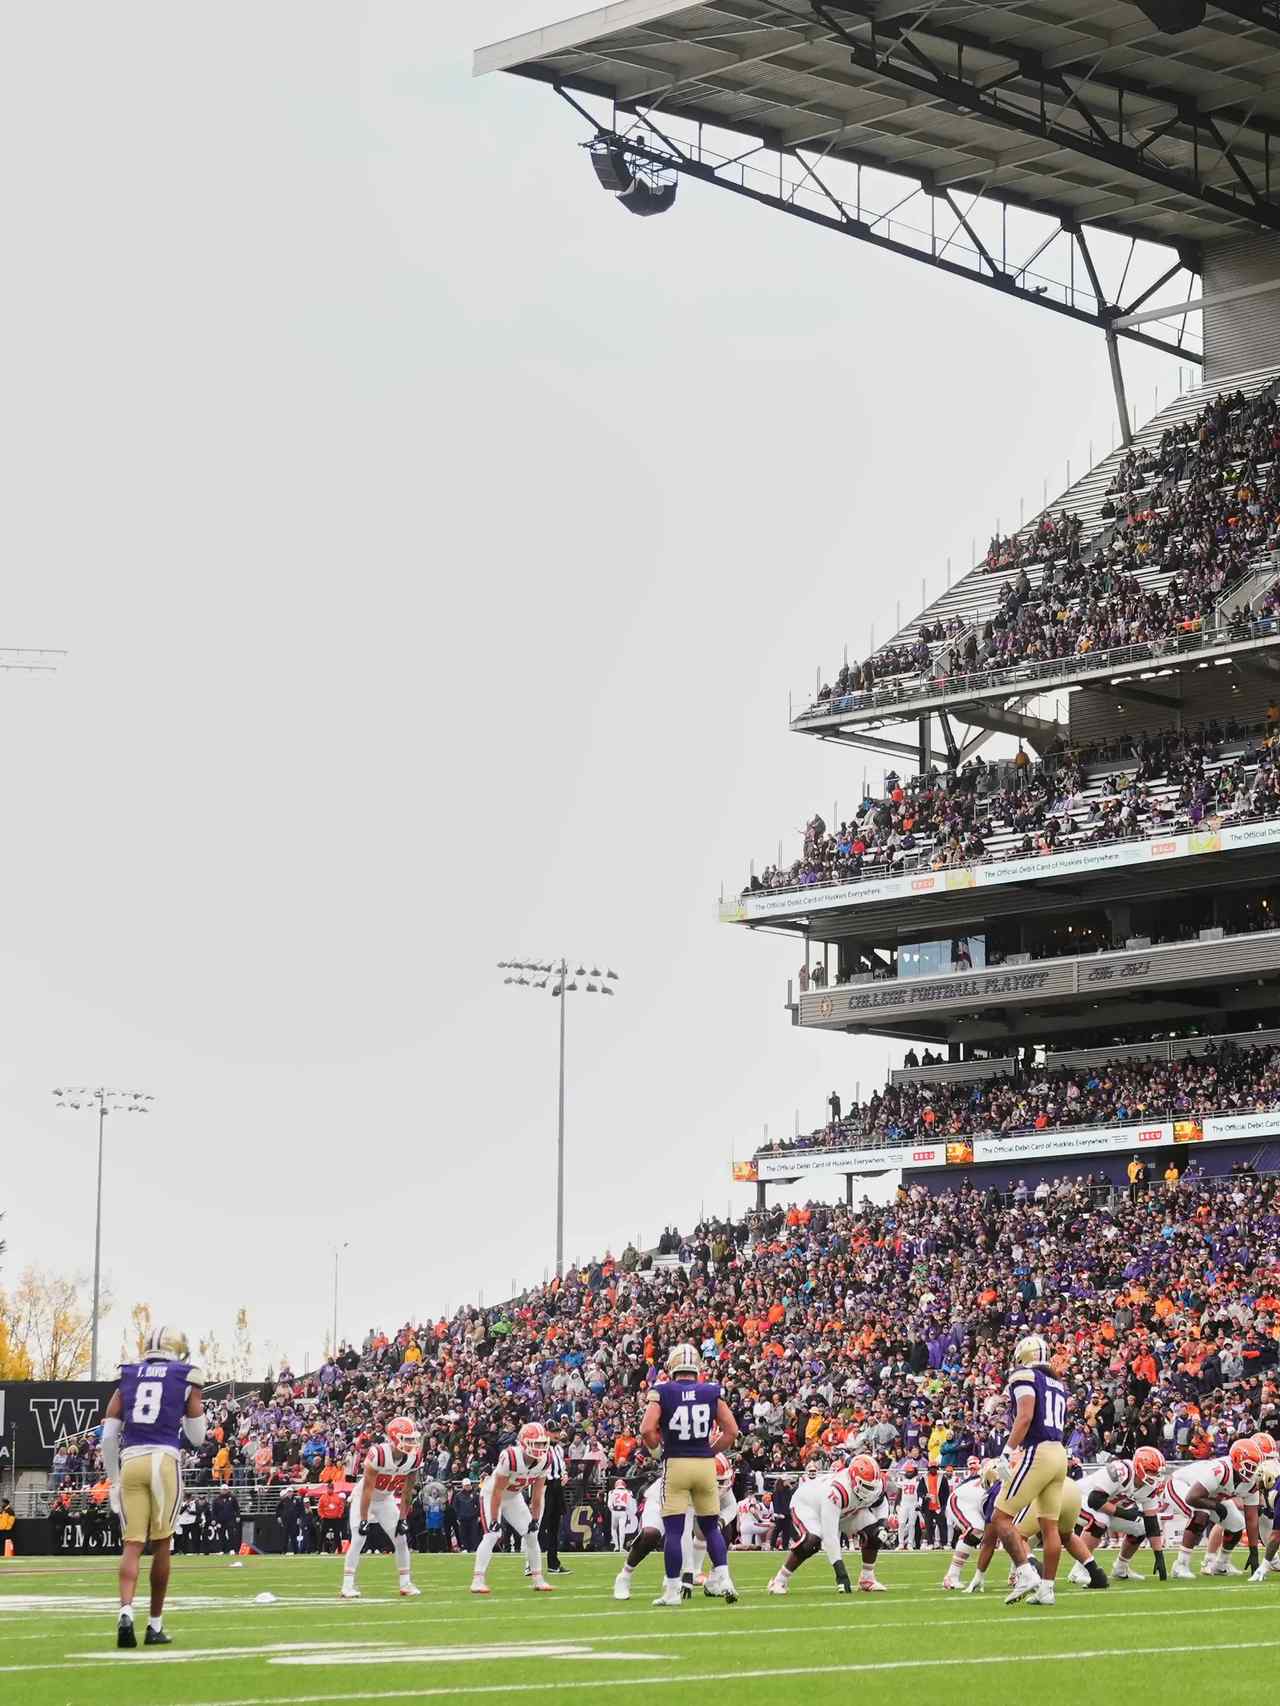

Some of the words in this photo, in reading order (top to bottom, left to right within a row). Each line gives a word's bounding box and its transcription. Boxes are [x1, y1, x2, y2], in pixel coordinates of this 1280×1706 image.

[132, 1381, 163, 1424] 8
[668, 1403, 711, 1441] 48
[1044, 1390, 1066, 1432] 10
